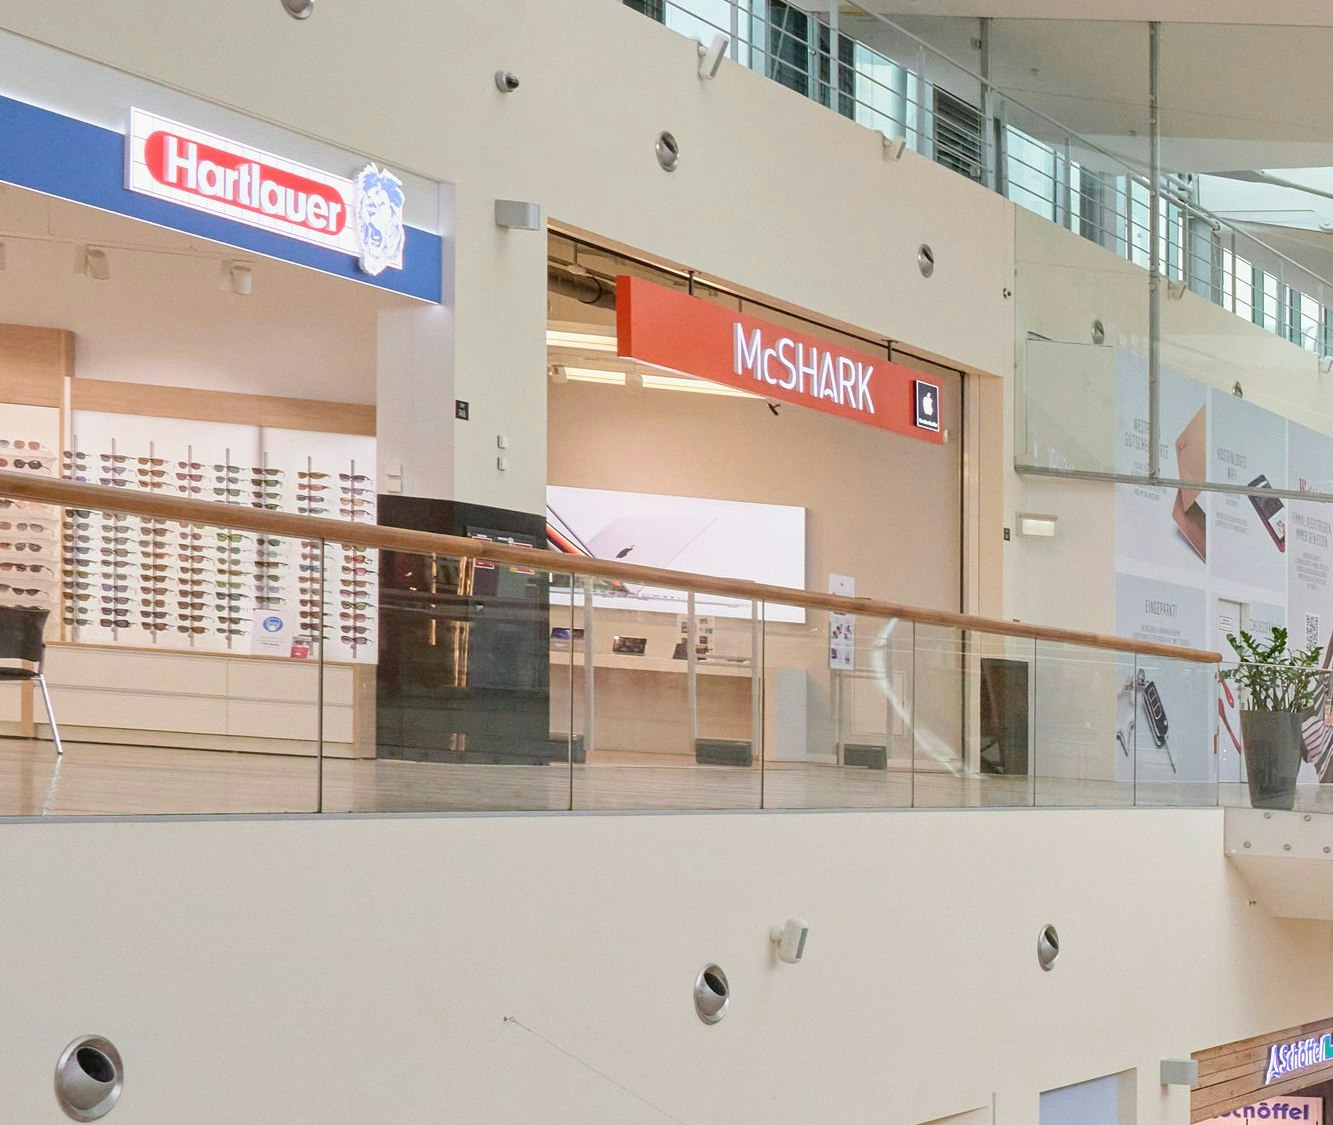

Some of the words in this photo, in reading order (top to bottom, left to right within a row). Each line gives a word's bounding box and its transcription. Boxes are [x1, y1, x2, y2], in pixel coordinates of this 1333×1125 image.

[163, 136, 342, 233] Hartlauer
[733, 322, 875, 414] McSHARK
[1279, 1036, 1324, 1073] Schöffel
